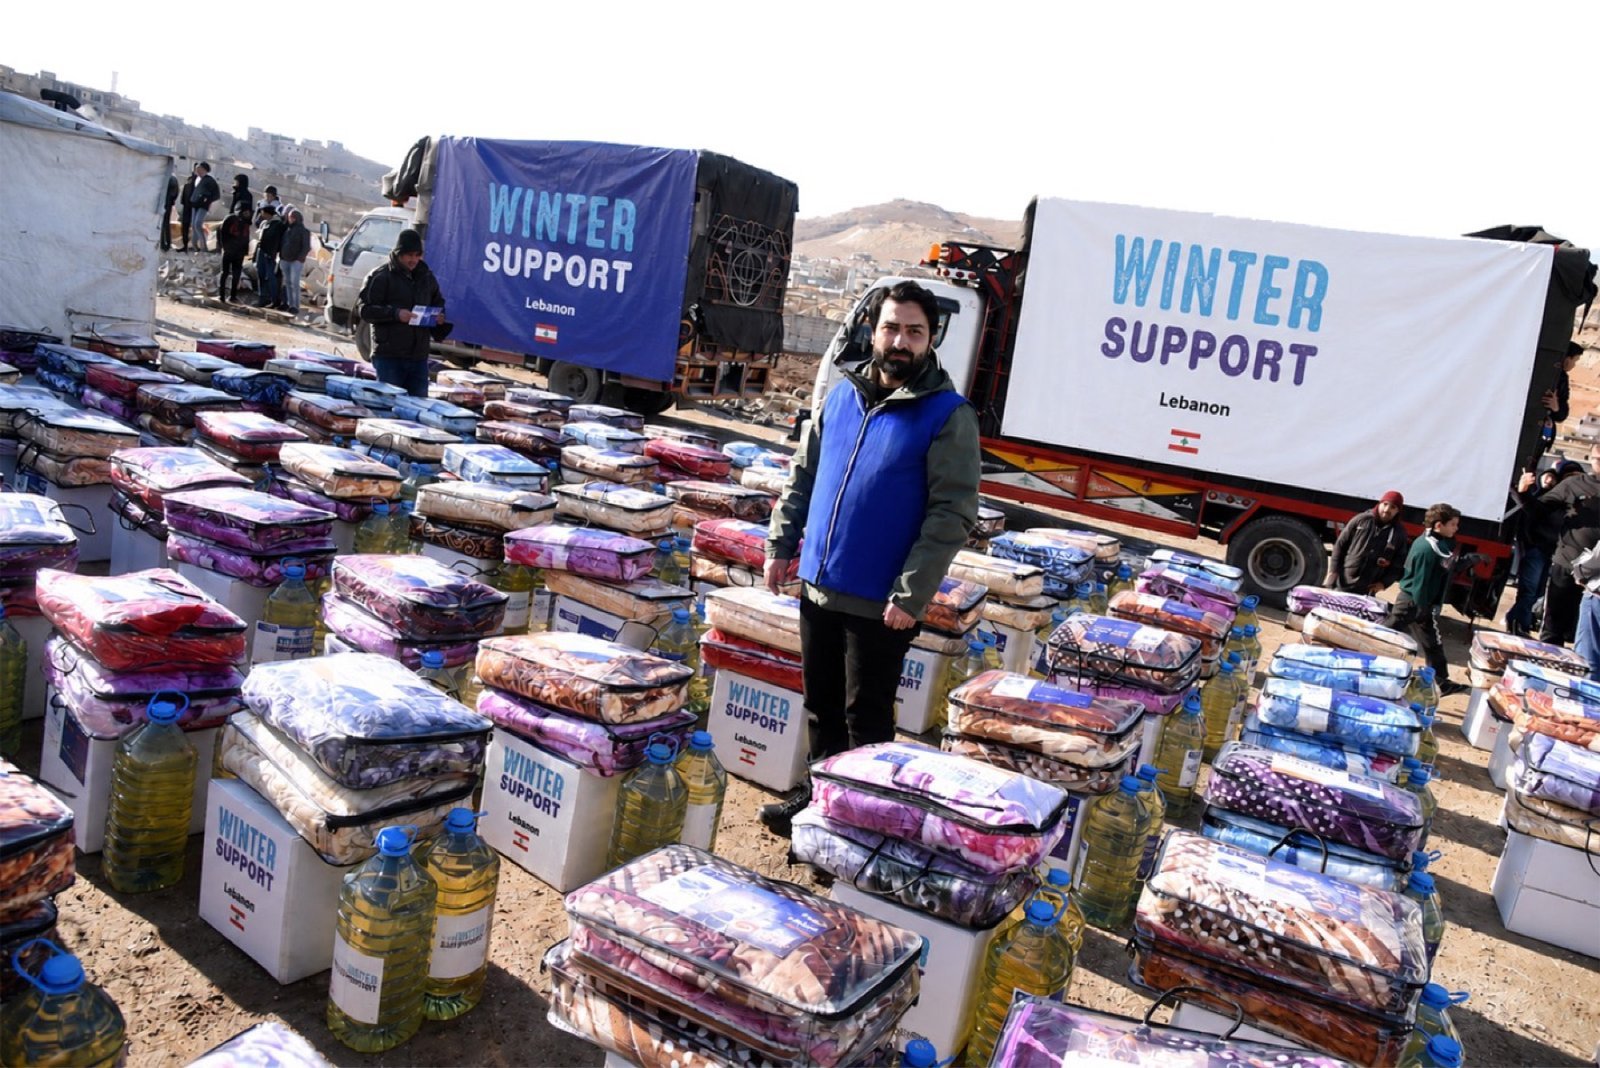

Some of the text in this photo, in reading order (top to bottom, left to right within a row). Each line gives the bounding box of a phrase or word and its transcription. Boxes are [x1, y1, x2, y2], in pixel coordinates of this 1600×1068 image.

[489, 182, 637, 252] WINTER
[483, 241, 633, 293] SUPPORT
[1113, 233, 1329, 332] WINTER
[525, 297, 576, 317] Lebanon
[1100, 316, 1319, 386] SUPPORT
[1159, 392, 1231, 417] Lebanon
[902, 658, 925, 680] TER
[725, 702, 788, 735] SUPPORT
[728, 680, 791, 721] WINTER
[734, 732, 767, 751] Lebanon
[503, 745, 565, 801] WINTER
[500, 774, 561, 818] SUPPORT
[218, 805, 277, 871] WINTER
[508, 811, 540, 837] Lebanon
[215, 837, 274, 892] SUPPORT
[223, 881, 256, 913] Lebanon
